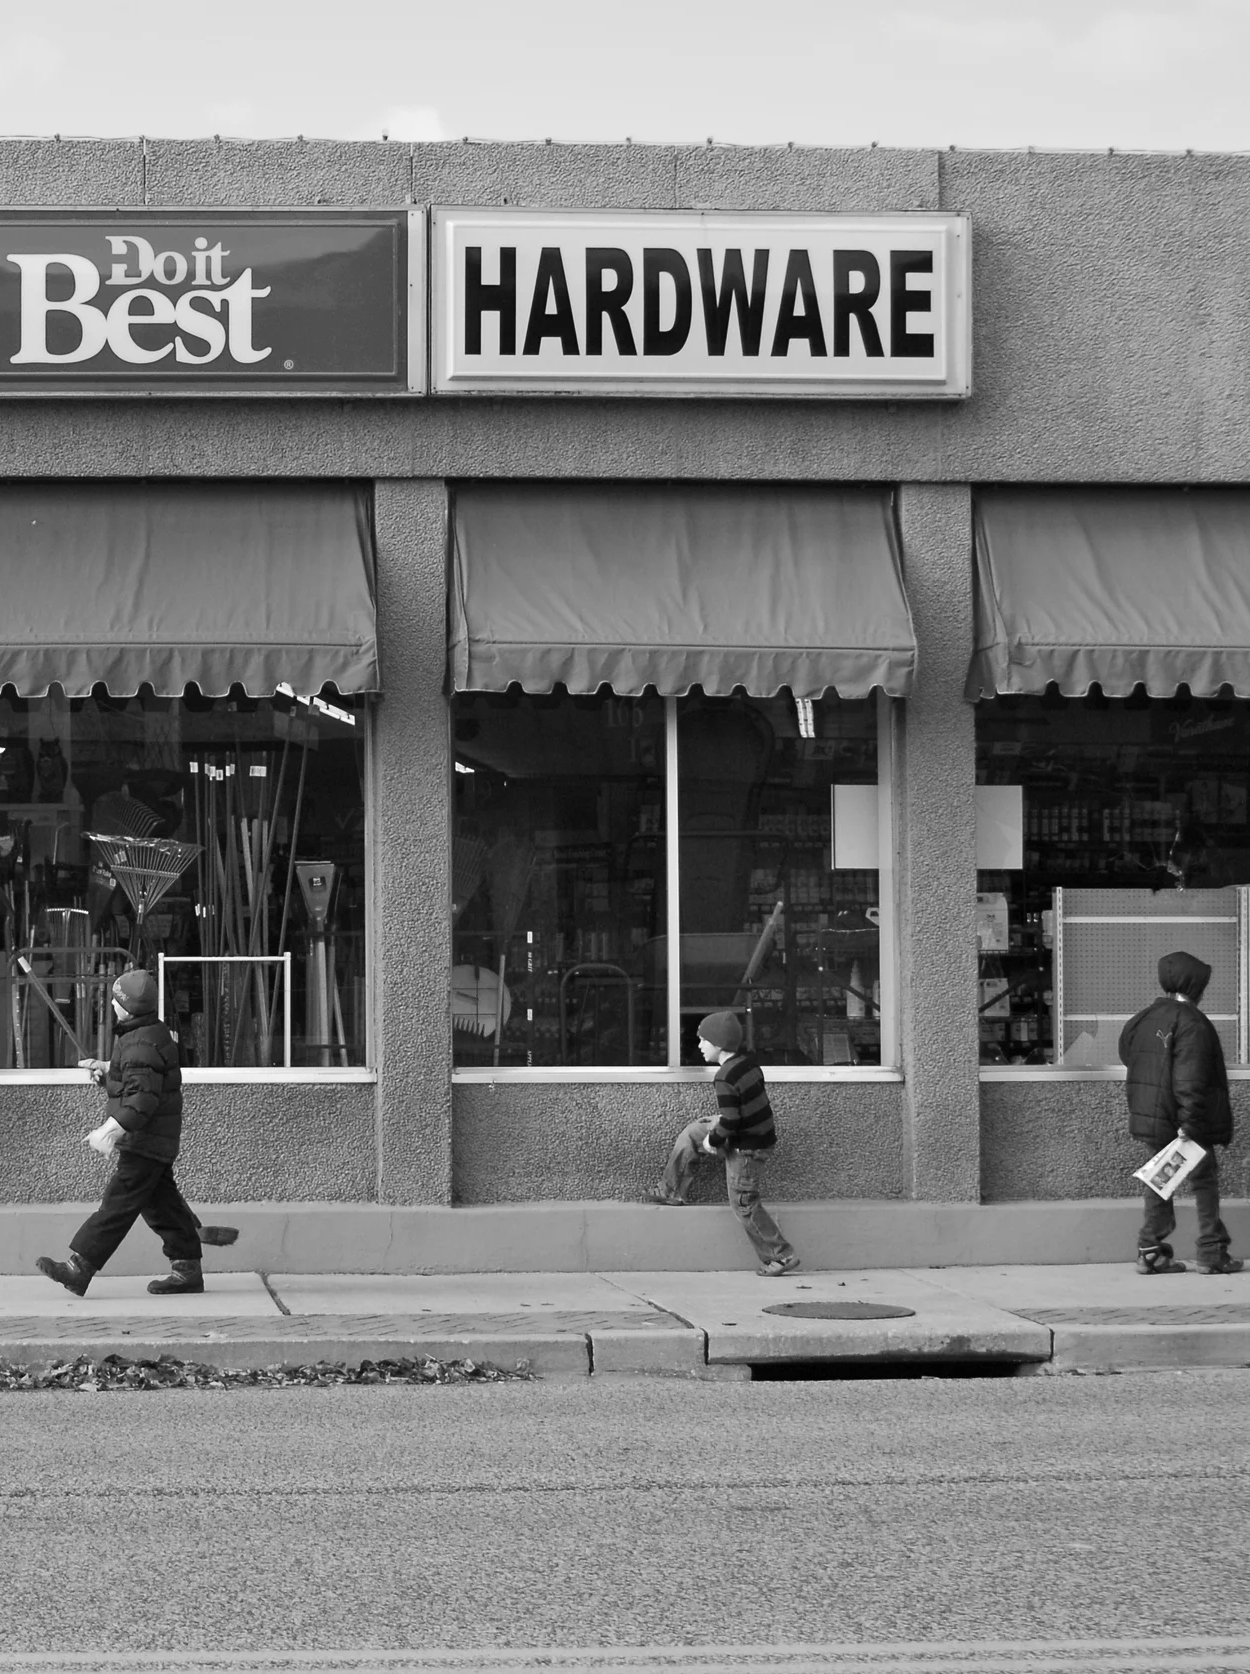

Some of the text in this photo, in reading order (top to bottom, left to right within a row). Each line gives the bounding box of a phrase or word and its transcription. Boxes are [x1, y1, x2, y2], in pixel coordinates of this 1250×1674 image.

[6, 253, 272, 365] Best
[105, 235, 230, 286] Do it
[464, 246, 936, 358] HARDWARE
